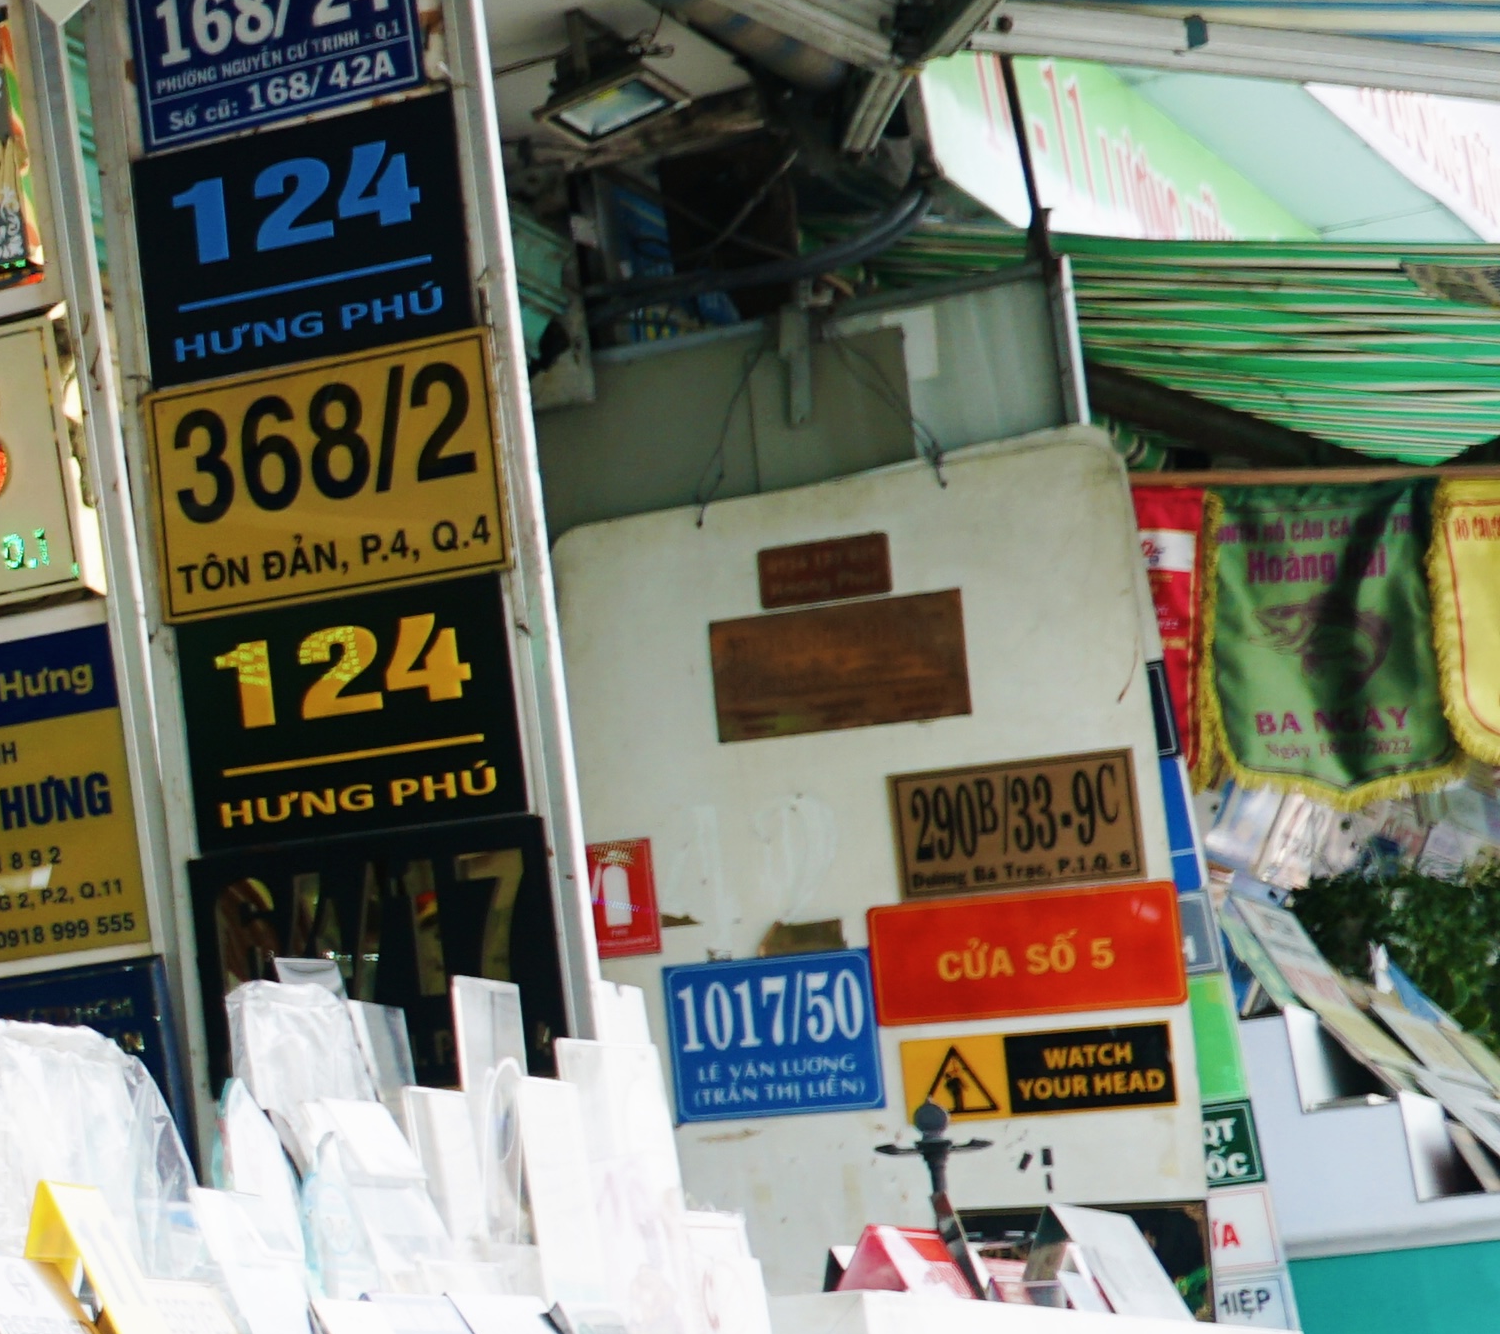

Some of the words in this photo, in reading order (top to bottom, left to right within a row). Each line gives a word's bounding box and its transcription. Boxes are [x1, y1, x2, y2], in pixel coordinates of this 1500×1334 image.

[169, 102, 198, 132] Số
[205, 97, 239, 123] cũ:
[247, 48, 397, 113] 168/42A
[172, 139, 421, 265] 124
[173, 311, 324, 363] HƯNG
[340, 279, 444, 331] PHÚ
[173, 361, 478, 525] 368/2
[178, 555, 251, 595] TÔN
[262, 535, 349, 581] ĐẢN,
[360, 530, 421, 566] P.4,
[432, 514, 491, 554] Q.4
[1246, 548, 1338, 586] Hoàng
[213, 612, 472, 729] 124
[0, 771, 113, 830] HƯNG
[220, 783, 375, 829] HƯNG
[389, 760, 498, 807] PHÚ
[51, 918, 90, 942] 999
[96, 912, 136, 936] 555
[936, 941, 1015, 983] CỬA
[1026, 928, 1081, 975] SỐ
[1090, 938, 1117, 972] 5
[676, 968, 867, 1054] 1017/50
[698, 1061, 722, 1084] LÊ
[728, 1058, 777, 1081] VĂN
[781, 1052, 857, 1078] LƯƠNG
[1017, 1075, 1090, 1102] YOUR
[1094, 1070, 1167, 1097] HEAD
[1043, 1040, 1133, 1071] WATCH
